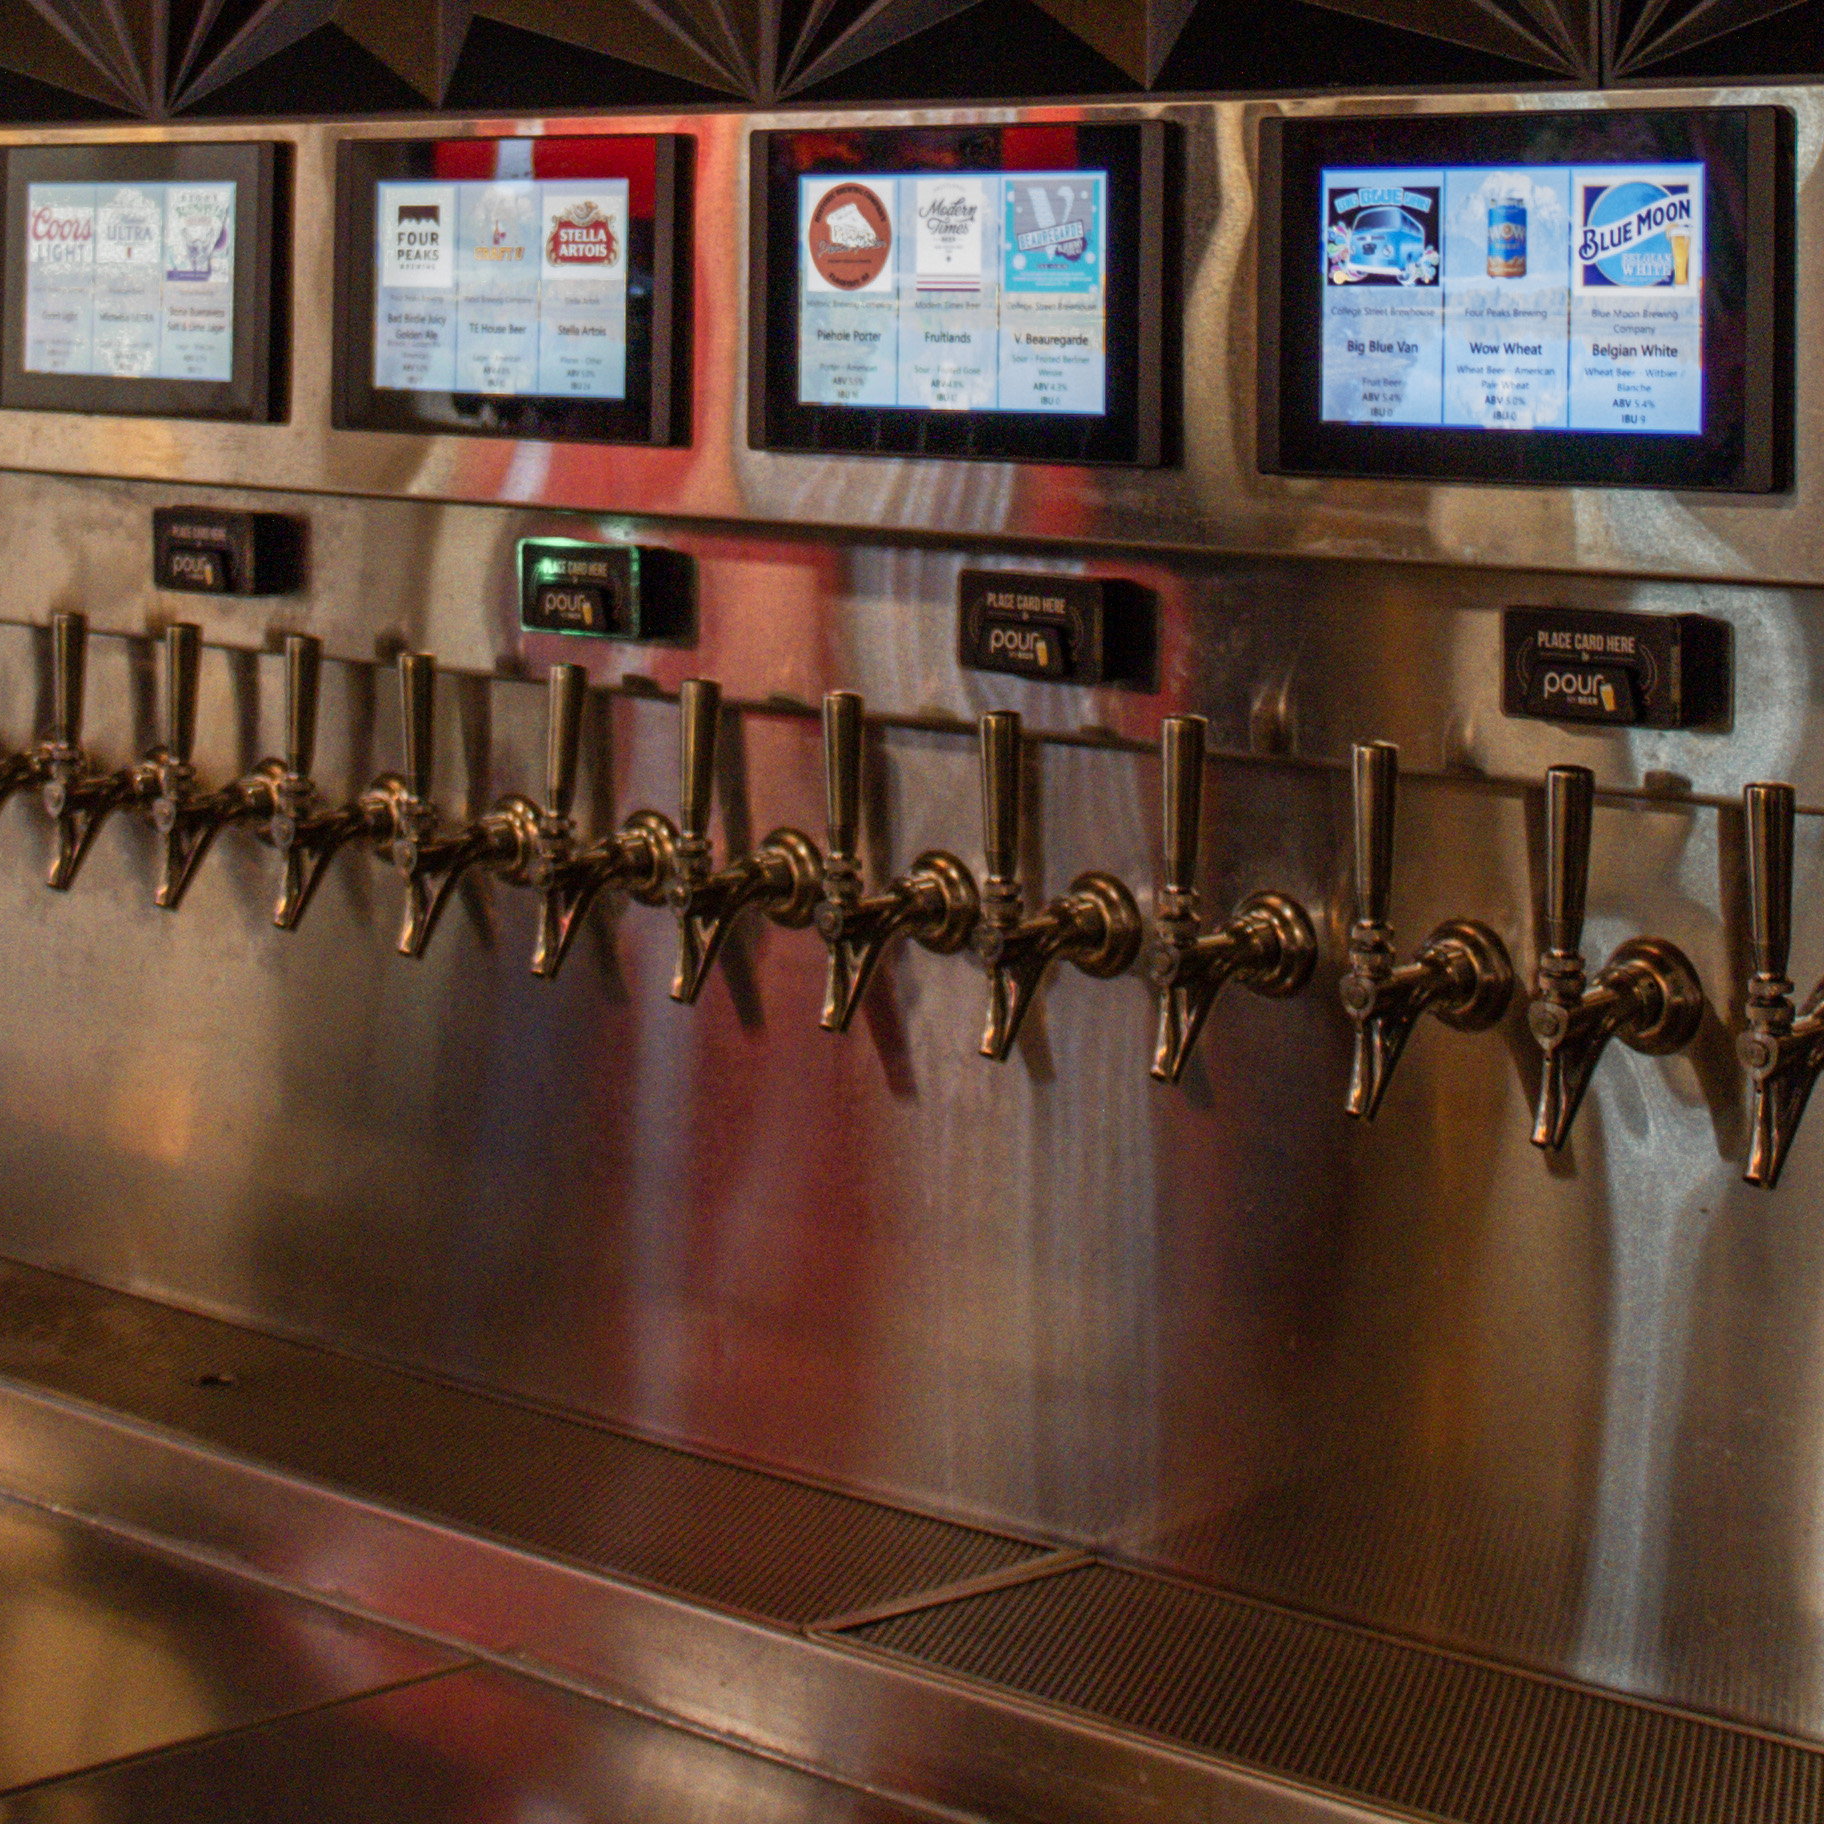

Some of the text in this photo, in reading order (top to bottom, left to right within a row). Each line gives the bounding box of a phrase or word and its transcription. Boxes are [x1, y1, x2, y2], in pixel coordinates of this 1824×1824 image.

[1359, 189, 1403, 207] BLUE
[919, 197, 977, 219] Modern
[31, 207, 92, 241] Coors
[927, 218, 969, 235] Times
[1578, 199, 1691, 261] BLUE MOON
[107, 227, 152, 241] ULTRA
[398, 232, 439, 246] FOUR
[560, 229, 607, 242] STELLA
[1019, 222, 1083, 251] BEAUREGARDE
[37, 244, 85, 262] LIGHT
[398, 250, 439, 260] PEAKS
[474, 247, 512, 261] CRAFT
[559, 244, 607, 257] ARTOIS
[1622, 253, 1673, 264] BELGIAN
[1622, 263, 1672, 277] WHITE
[1331, 307, 1435, 318] College Street Brewhouse
[1465, 308, 1548, 320] Four Peaks Brewing
[1592, 308, 1678, 321] Blue Moon Brewing
[481, 324, 507, 334] House
[509, 325, 526, 335] Beer
[558, 325, 607, 337] Stella Artois
[817, 330, 881, 342] Piehole Porter
[1613, 324, 1655, 335] Company
[924, 331, 971, 344] Fruitlands
[1014, 333, 1089, 348] V. Beauregarde
[1347, 340, 1418, 356] Big Blue Van
[1469, 342, 1543, 356] Wow Wheat
[1592, 343, 1678, 360] Belgian White
[1456, 365, 1484, 375] Wheat
[1514, 367, 1555, 376] American
[1584, 367, 1613, 377] Wheat
[1033, 383, 1049, 391] ABV
[1362, 377, 1401, 388] Fruit Beer
[1362, 392, 1380, 402] ABV
[1485, 395, 1503, 405] ABV
[1612, 399, 1631, 408] ABV
[1370, 407, 1386, 417] IBU
[1622, 414, 1637, 424] IBU
[545, 593, 585, 616] pour
[987, 592, 1066, 614] PLACE CARD HERE
[990, 629, 1039, 653] pour
[1538, 630, 1635, 654] PLACE CARD HERE
[1544, 672, 1604, 700] pour
